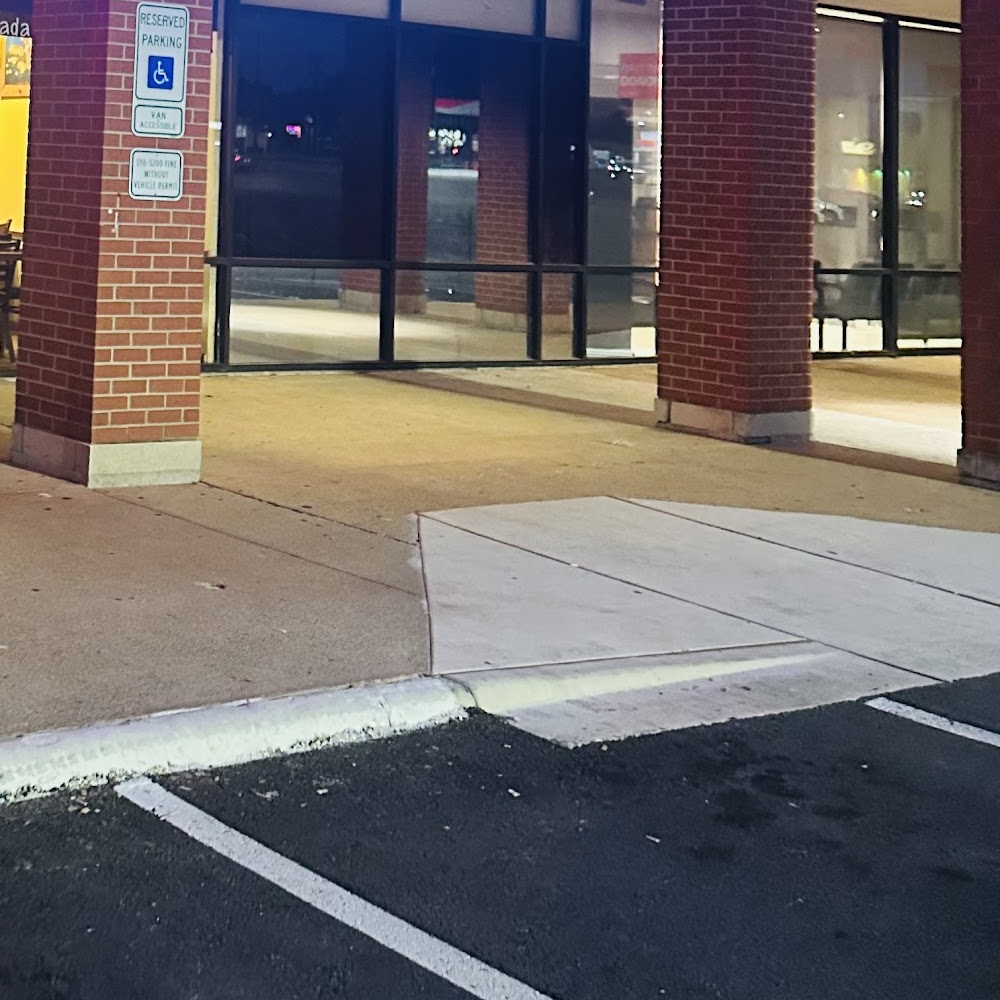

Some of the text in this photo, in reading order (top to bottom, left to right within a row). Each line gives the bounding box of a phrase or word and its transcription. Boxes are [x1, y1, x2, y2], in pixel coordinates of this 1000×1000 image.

[140, 12, 185, 29] RESERVED
[142, 33, 182, 49] PARKING
[151, 111, 167, 120] VAN
[140, 121, 177, 130] ACCESSIBLE
